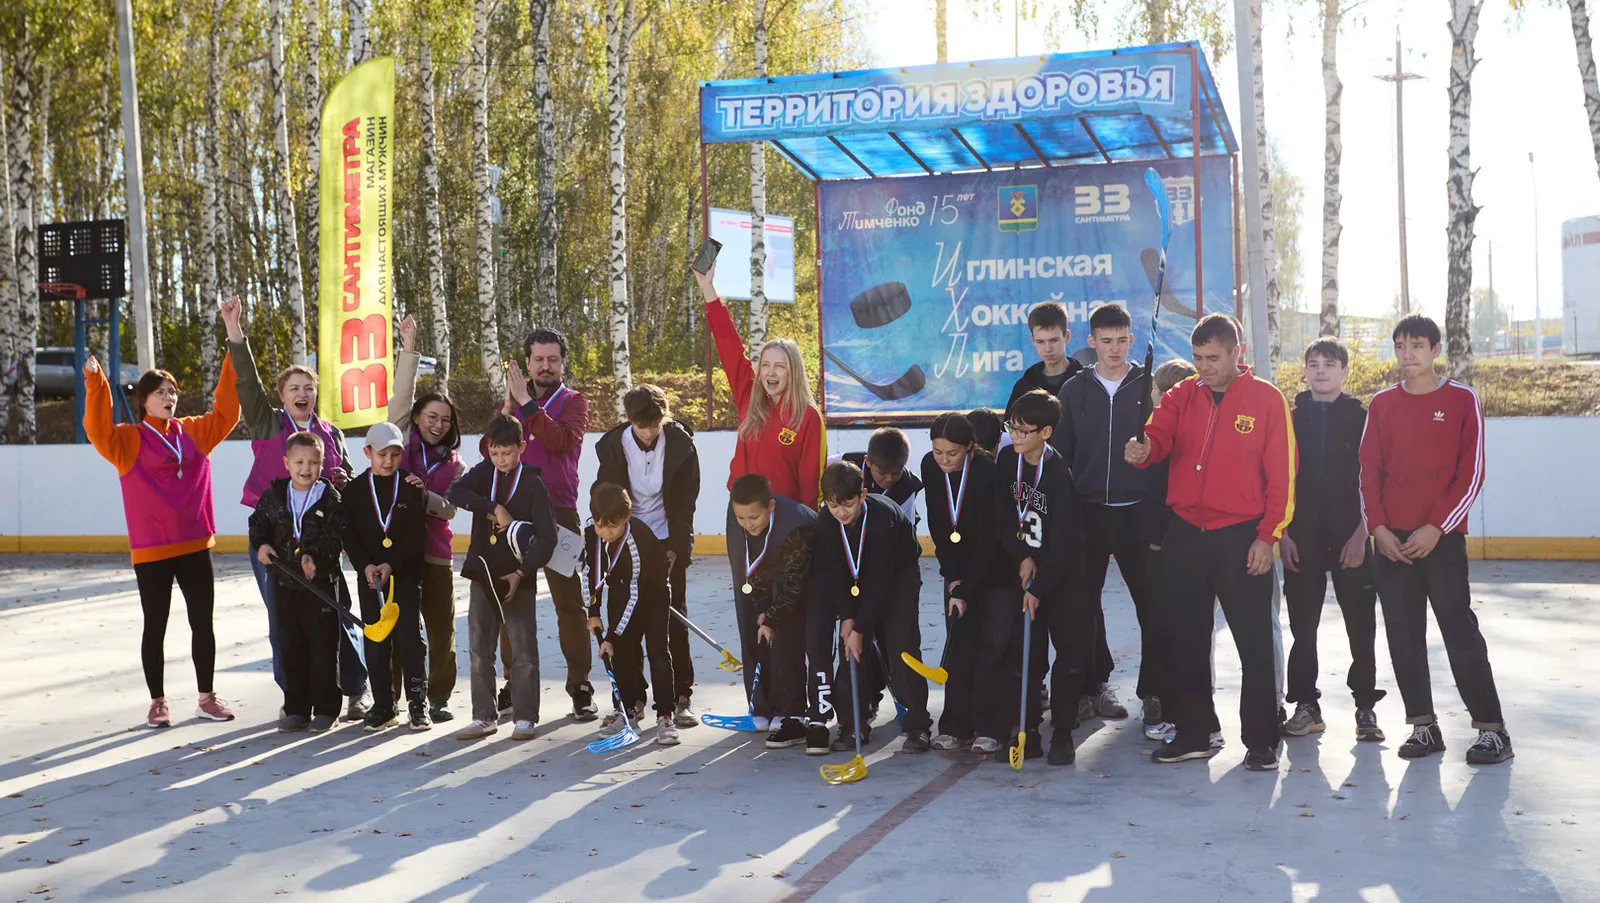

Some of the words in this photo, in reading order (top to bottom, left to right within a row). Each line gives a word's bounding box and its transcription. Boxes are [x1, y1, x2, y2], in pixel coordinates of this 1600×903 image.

[718, 83, 960, 131] ТЕРРИТОРИЯ
[962, 68, 1173, 118] ЗДОРОВЬЯ
[366, 116, 376, 189] МАГАЗИН
[378, 116, 387, 181] МУЖЧИН
[342, 117, 361, 312] САНТИМЕТРА
[838, 210, 920, 230] Тимченко
[886, 197, 926, 216] Фонд
[929, 194, 959, 226] 15
[956, 193, 976, 202] лет
[1074, 183, 1131, 215] 33
[1075, 214, 1131, 224] САНТИМЕТРА
[378, 184, 387, 275] НАСТОЯЩИХ
[932, 241, 1112, 288] Иглинская
[378, 277, 387, 305] ДЛЯ
[941, 287, 1127, 333] Хоккн
[340, 313, 388, 413] 33
[934, 333, 1024, 379] Лига
[816, 671, 832, 714] FILA
